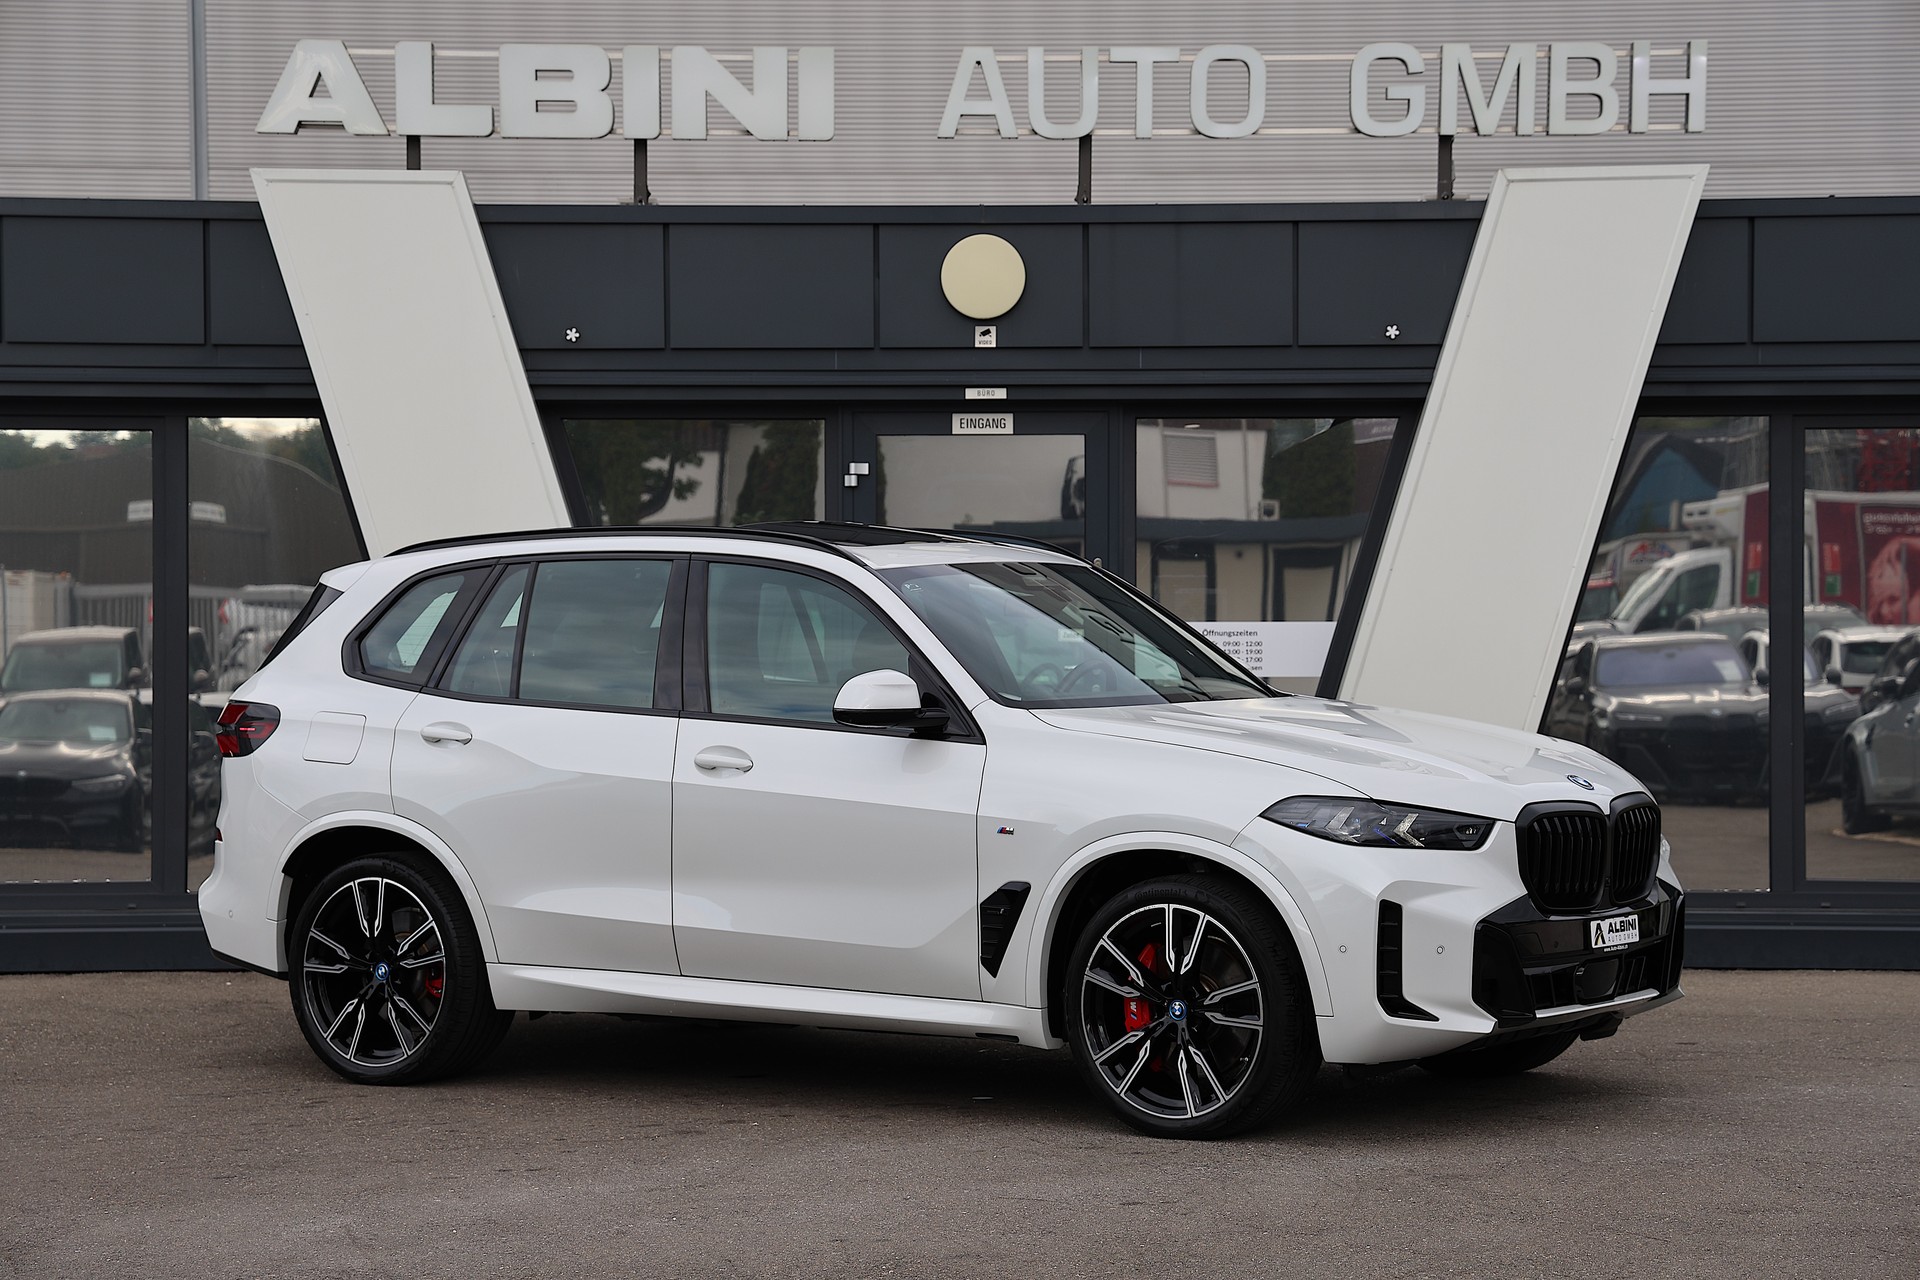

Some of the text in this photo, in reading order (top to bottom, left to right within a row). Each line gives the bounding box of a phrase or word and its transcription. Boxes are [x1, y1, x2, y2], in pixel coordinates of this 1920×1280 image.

[255, 39, 1708, 141] ALBINI AUTO GMBH
[977, 388, 996, 397] BÜRO
[959, 417, 1007, 429] EINGANG
[1202, 628, 1258, 637] Öffnungszeiten
[1608, 918, 1637, 934] ALBINI
